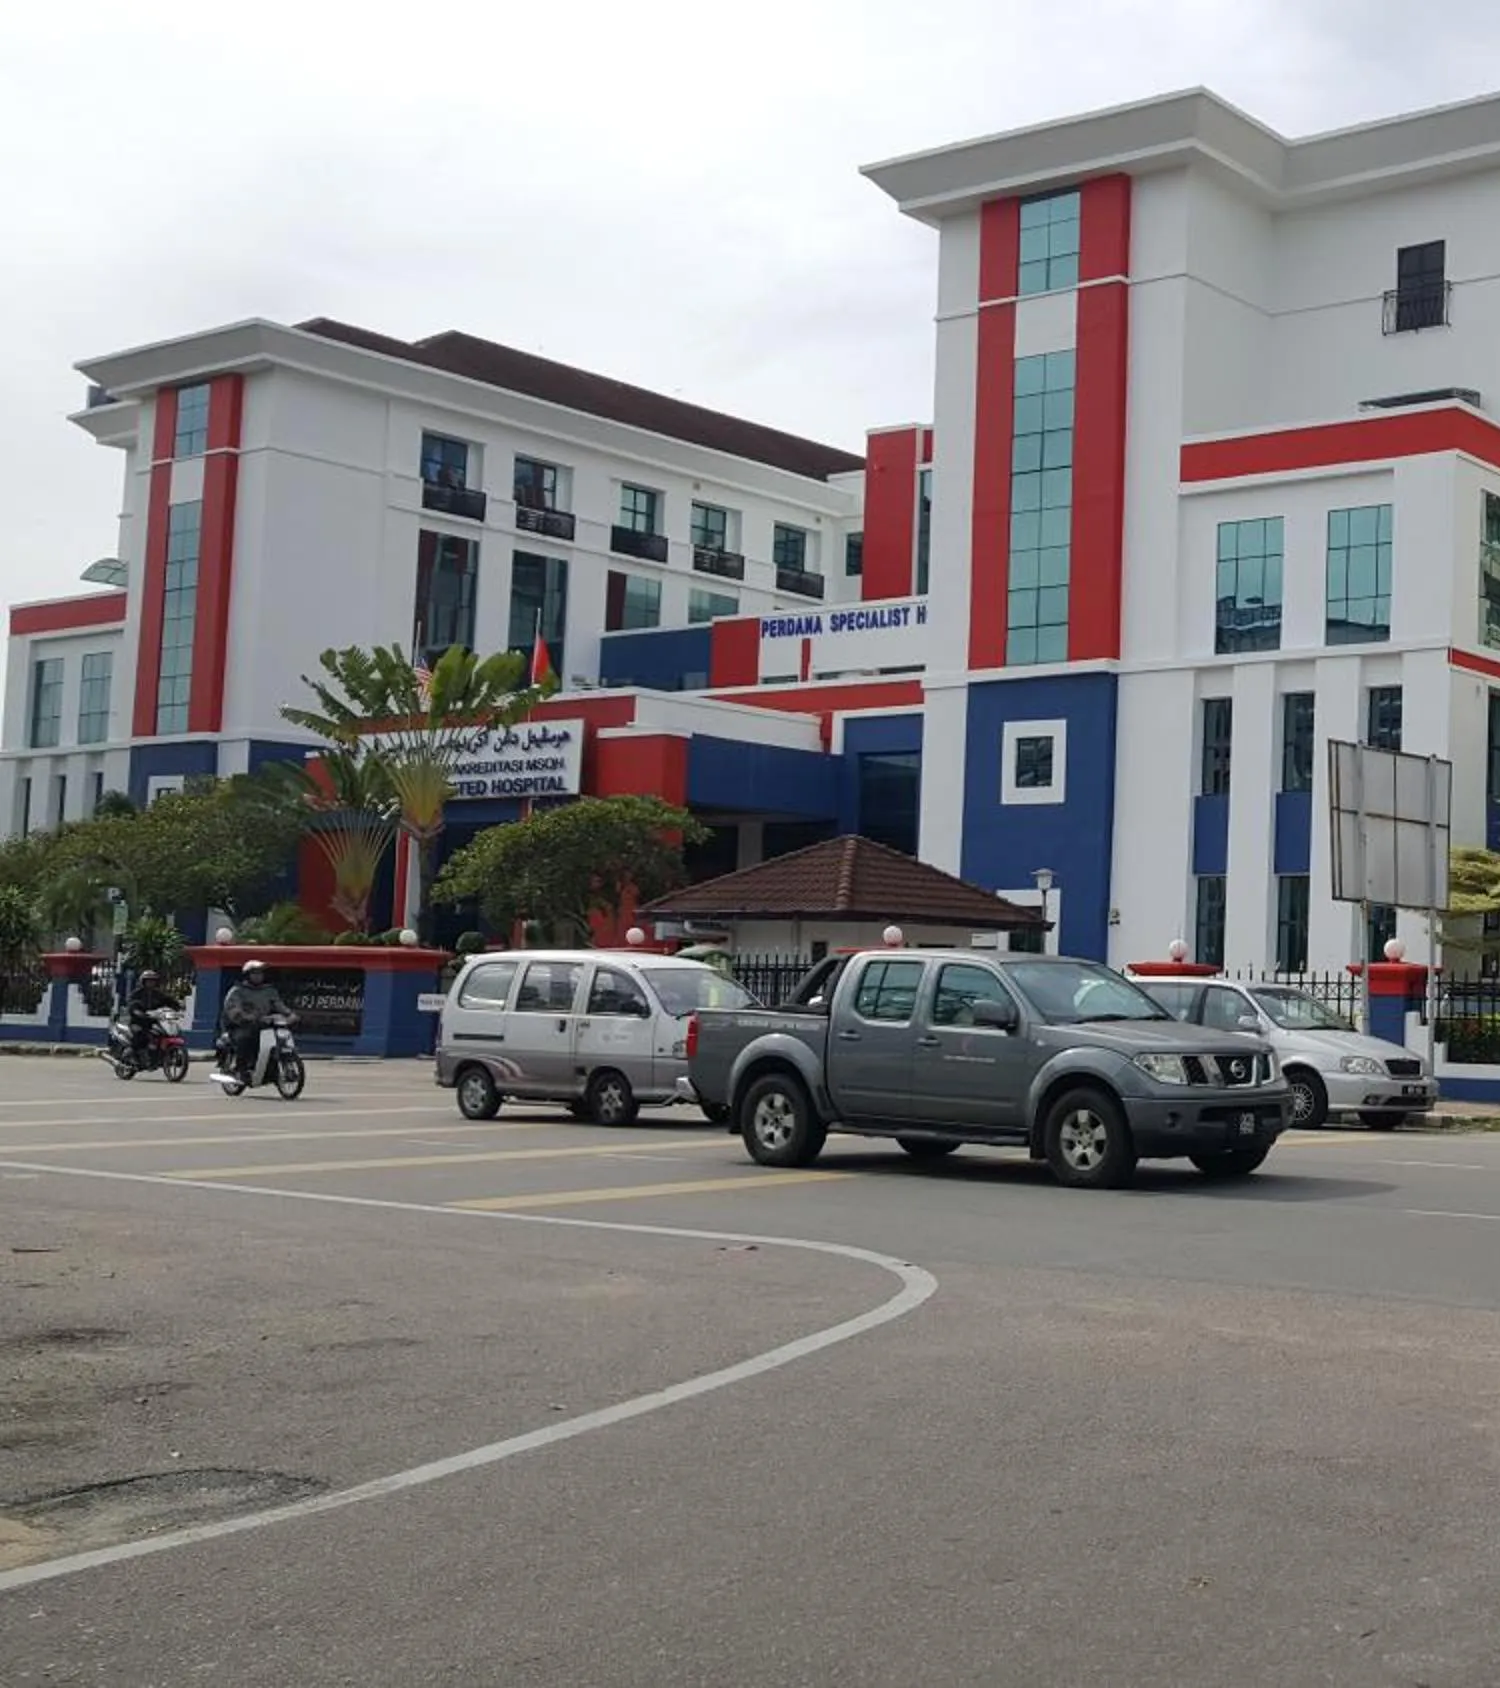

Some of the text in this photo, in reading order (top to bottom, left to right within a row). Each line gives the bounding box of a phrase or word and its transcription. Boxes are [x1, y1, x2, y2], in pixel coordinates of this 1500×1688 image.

[761, 616, 822, 638] PERDANA
[830, 607, 910, 632] SPECIALIST
[491, 776, 568, 794] HOSPITAL
